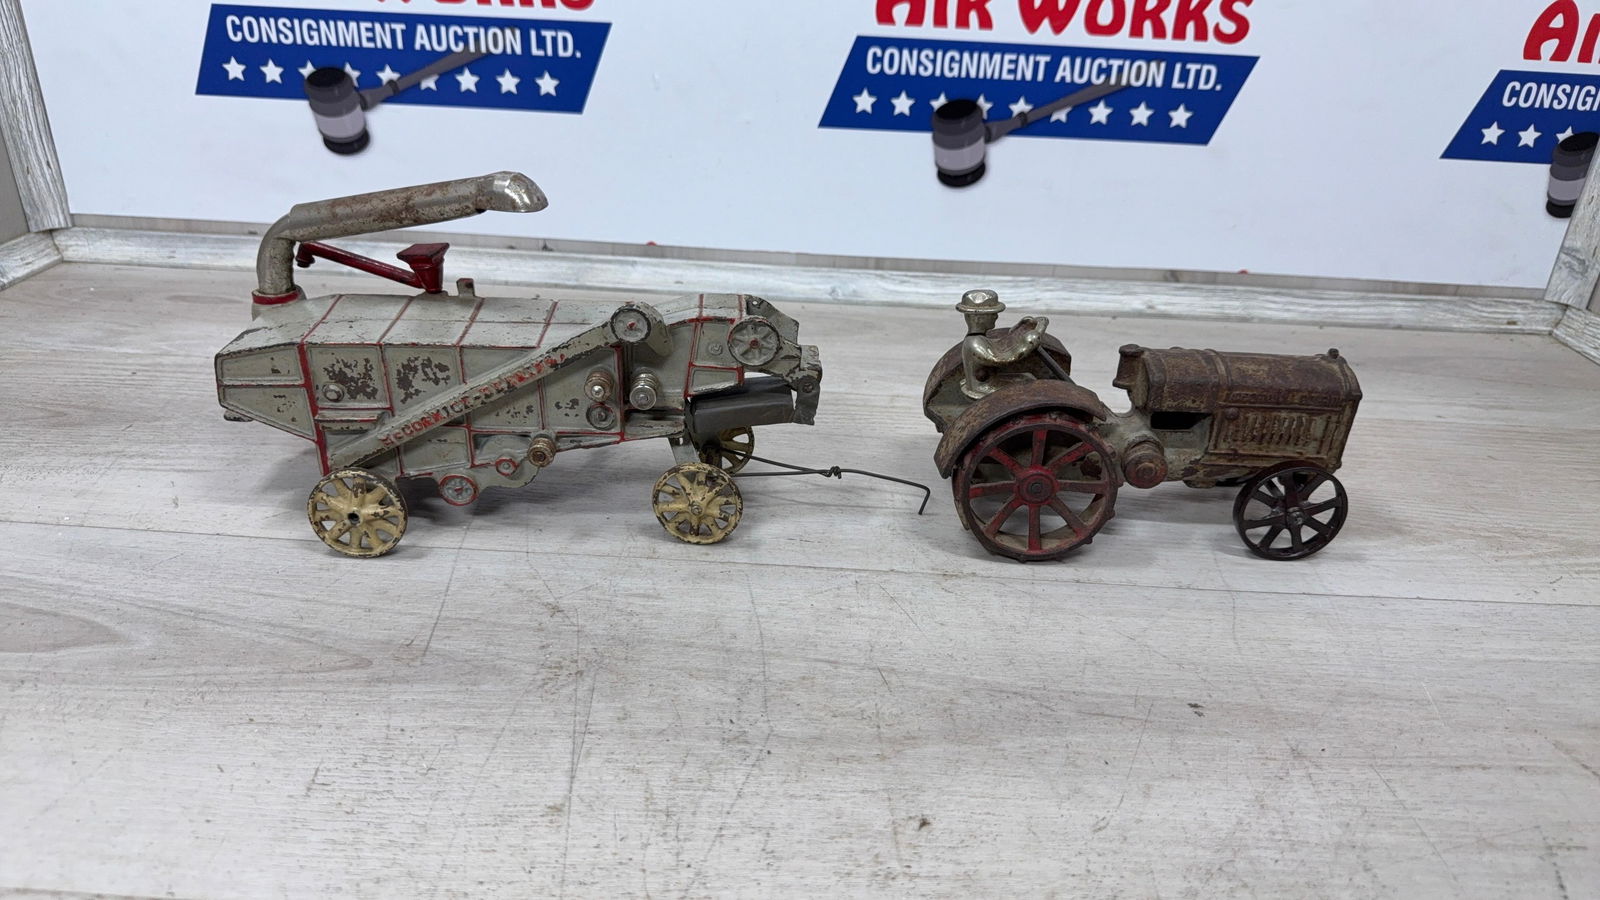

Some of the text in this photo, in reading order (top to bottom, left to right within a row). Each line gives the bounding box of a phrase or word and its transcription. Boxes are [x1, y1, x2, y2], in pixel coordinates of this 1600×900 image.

[226, 15, 582, 59] CONSIGNMENT AUCTION LTD.
[1018, 0, 1253, 44] WORKS
[1523, 0, 1600, 65] AI
[866, 46, 1223, 92] CONSIGNMENT AUCTION LTD.
